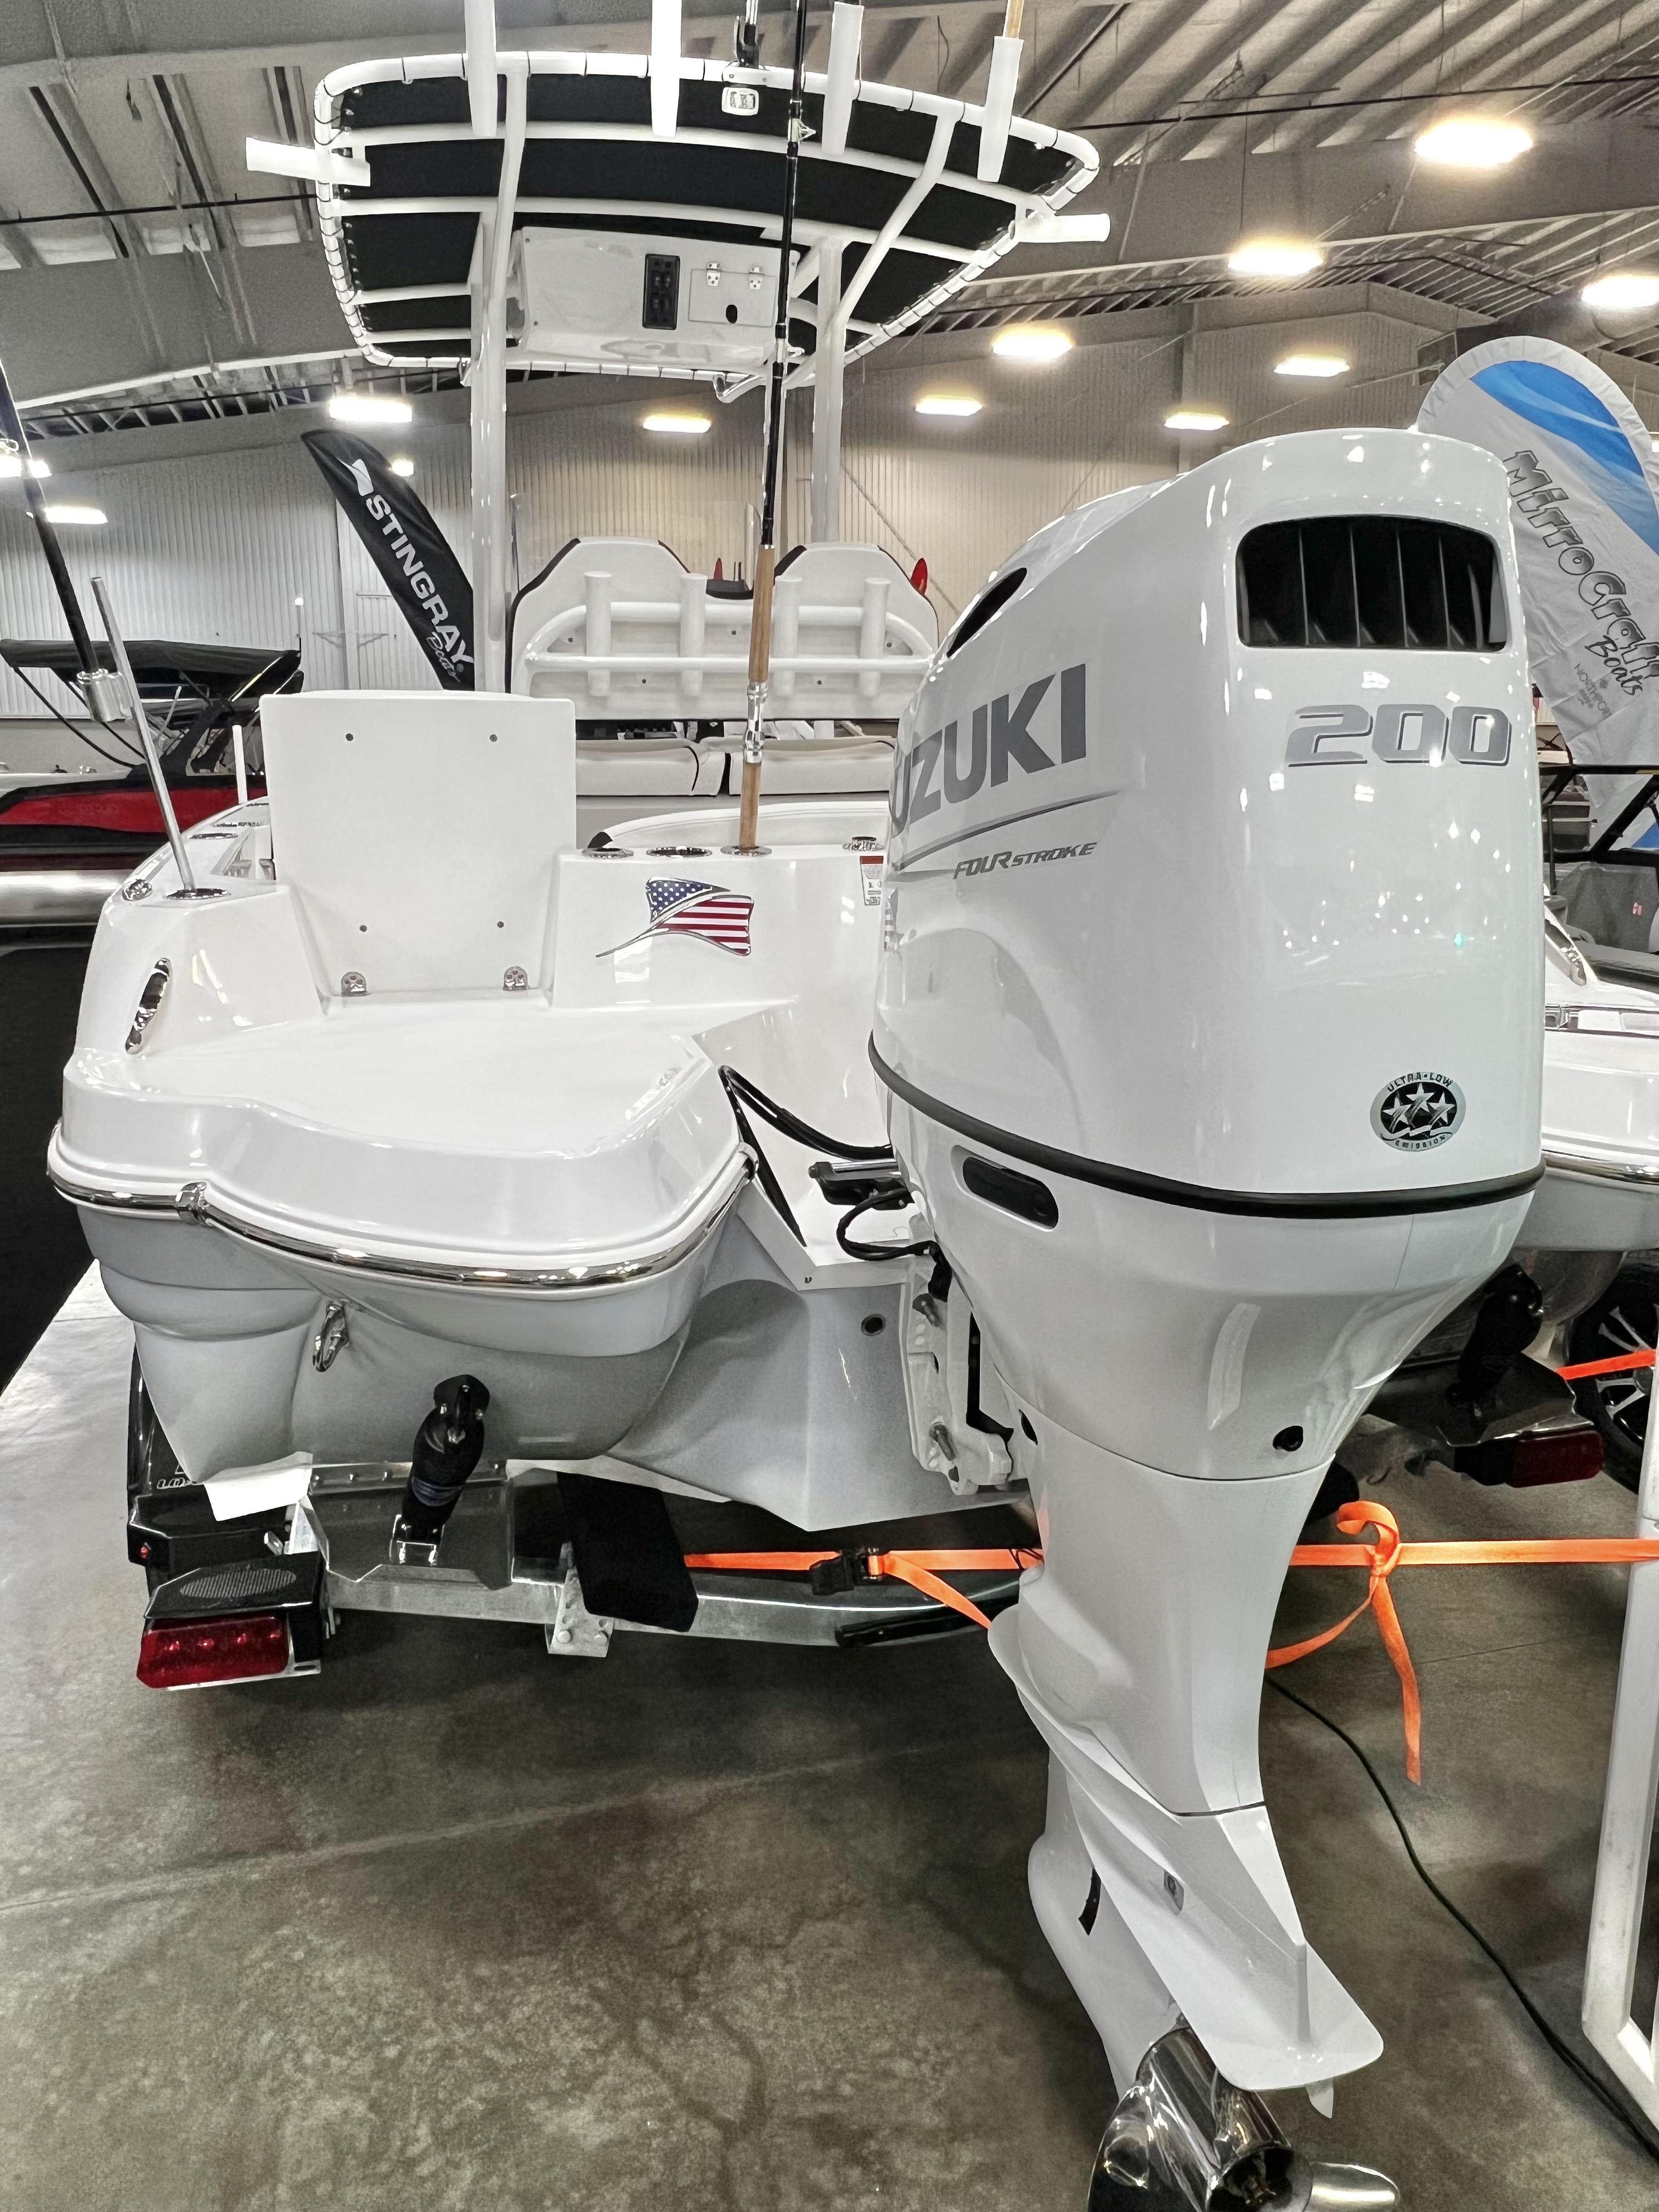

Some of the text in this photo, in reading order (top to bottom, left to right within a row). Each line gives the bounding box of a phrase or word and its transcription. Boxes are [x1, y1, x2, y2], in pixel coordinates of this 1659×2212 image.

[366, 494, 474, 663] STINGRAY
[1584, 635, 1643, 696] Boats
[889, 663, 1086, 839] UZUKI
[1284, 704, 1512, 767] 200
